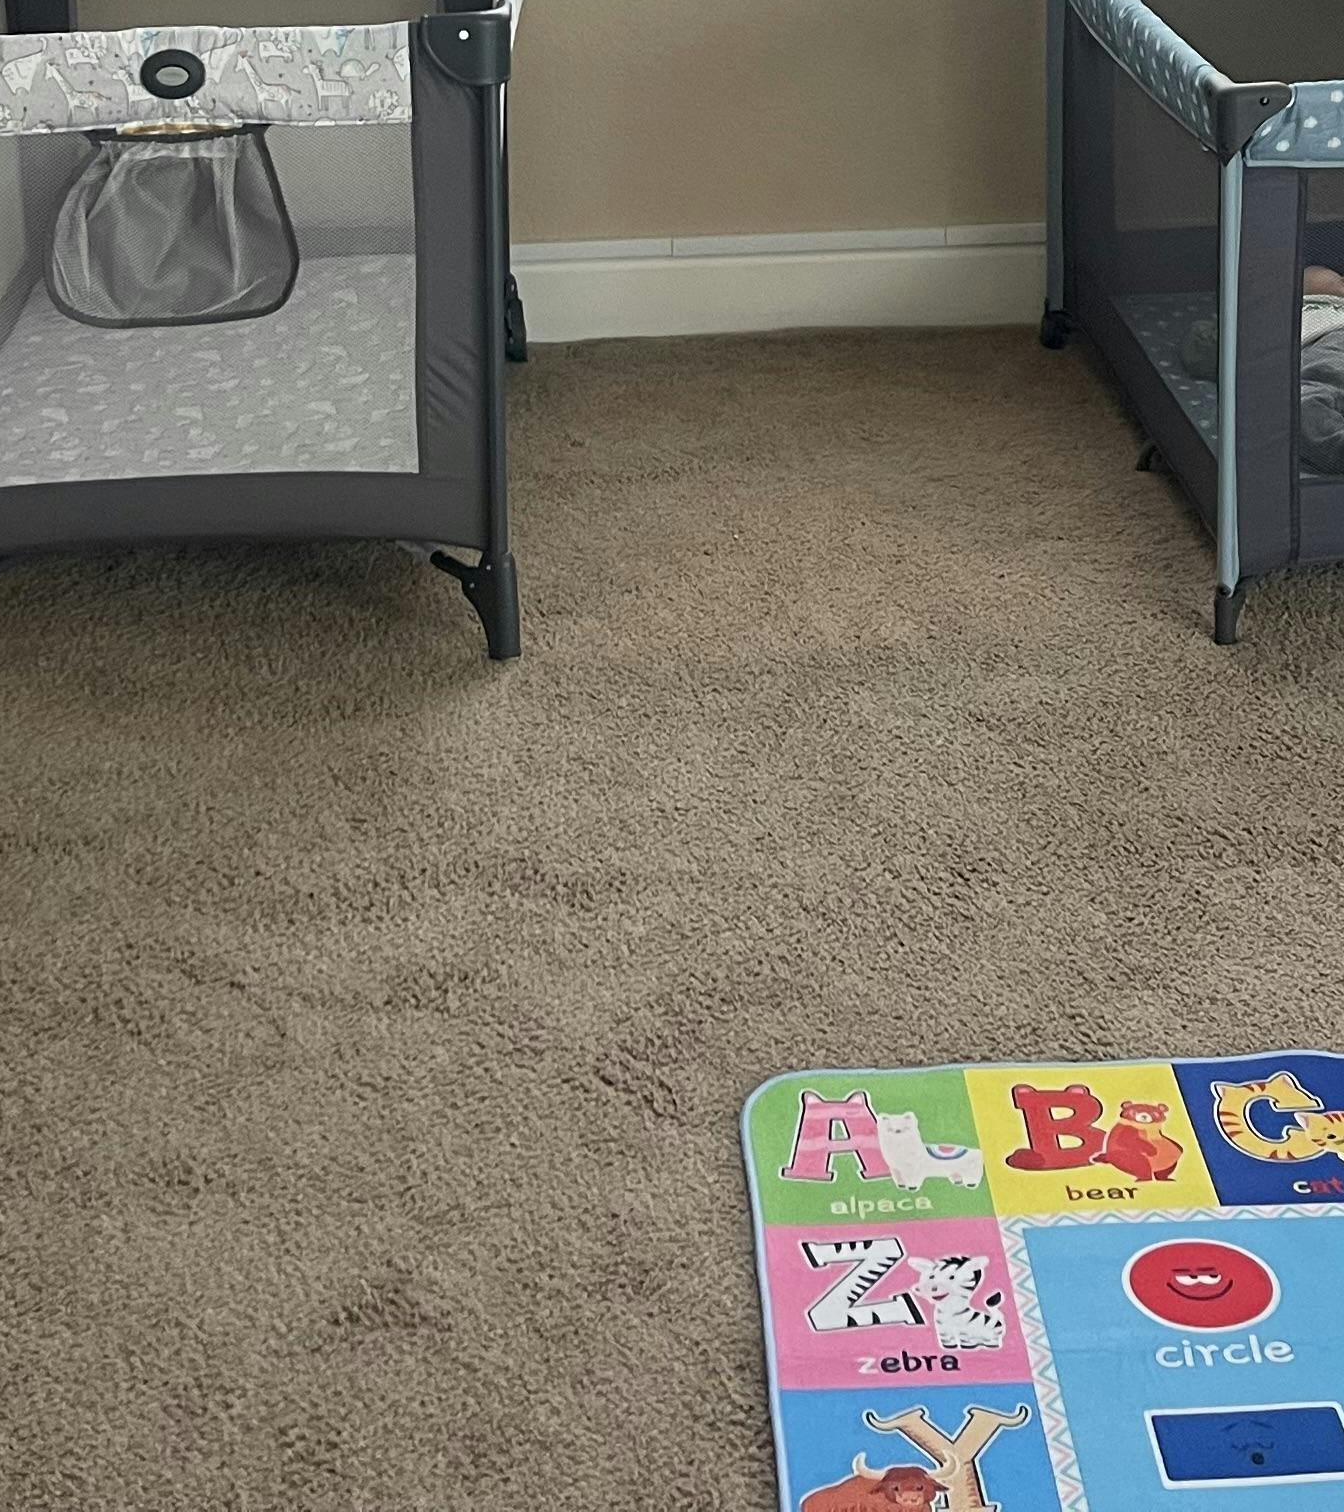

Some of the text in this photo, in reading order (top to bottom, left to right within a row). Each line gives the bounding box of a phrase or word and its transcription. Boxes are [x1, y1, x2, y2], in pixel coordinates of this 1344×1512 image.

[1005, 1083, 1108, 1172] B
[1210, 1070, 1328, 1163] C
[779, 1088, 894, 1182] A
[1065, 1183, 1139, 1203] bear
[1292, 1176, 1344, 1195] cat
[830, 1194, 934, 1220] alpaca
[800, 1237, 926, 1332] Z
[858, 1350, 961, 1375] zebra
[1155, 1334, 1295, 1369] circle
